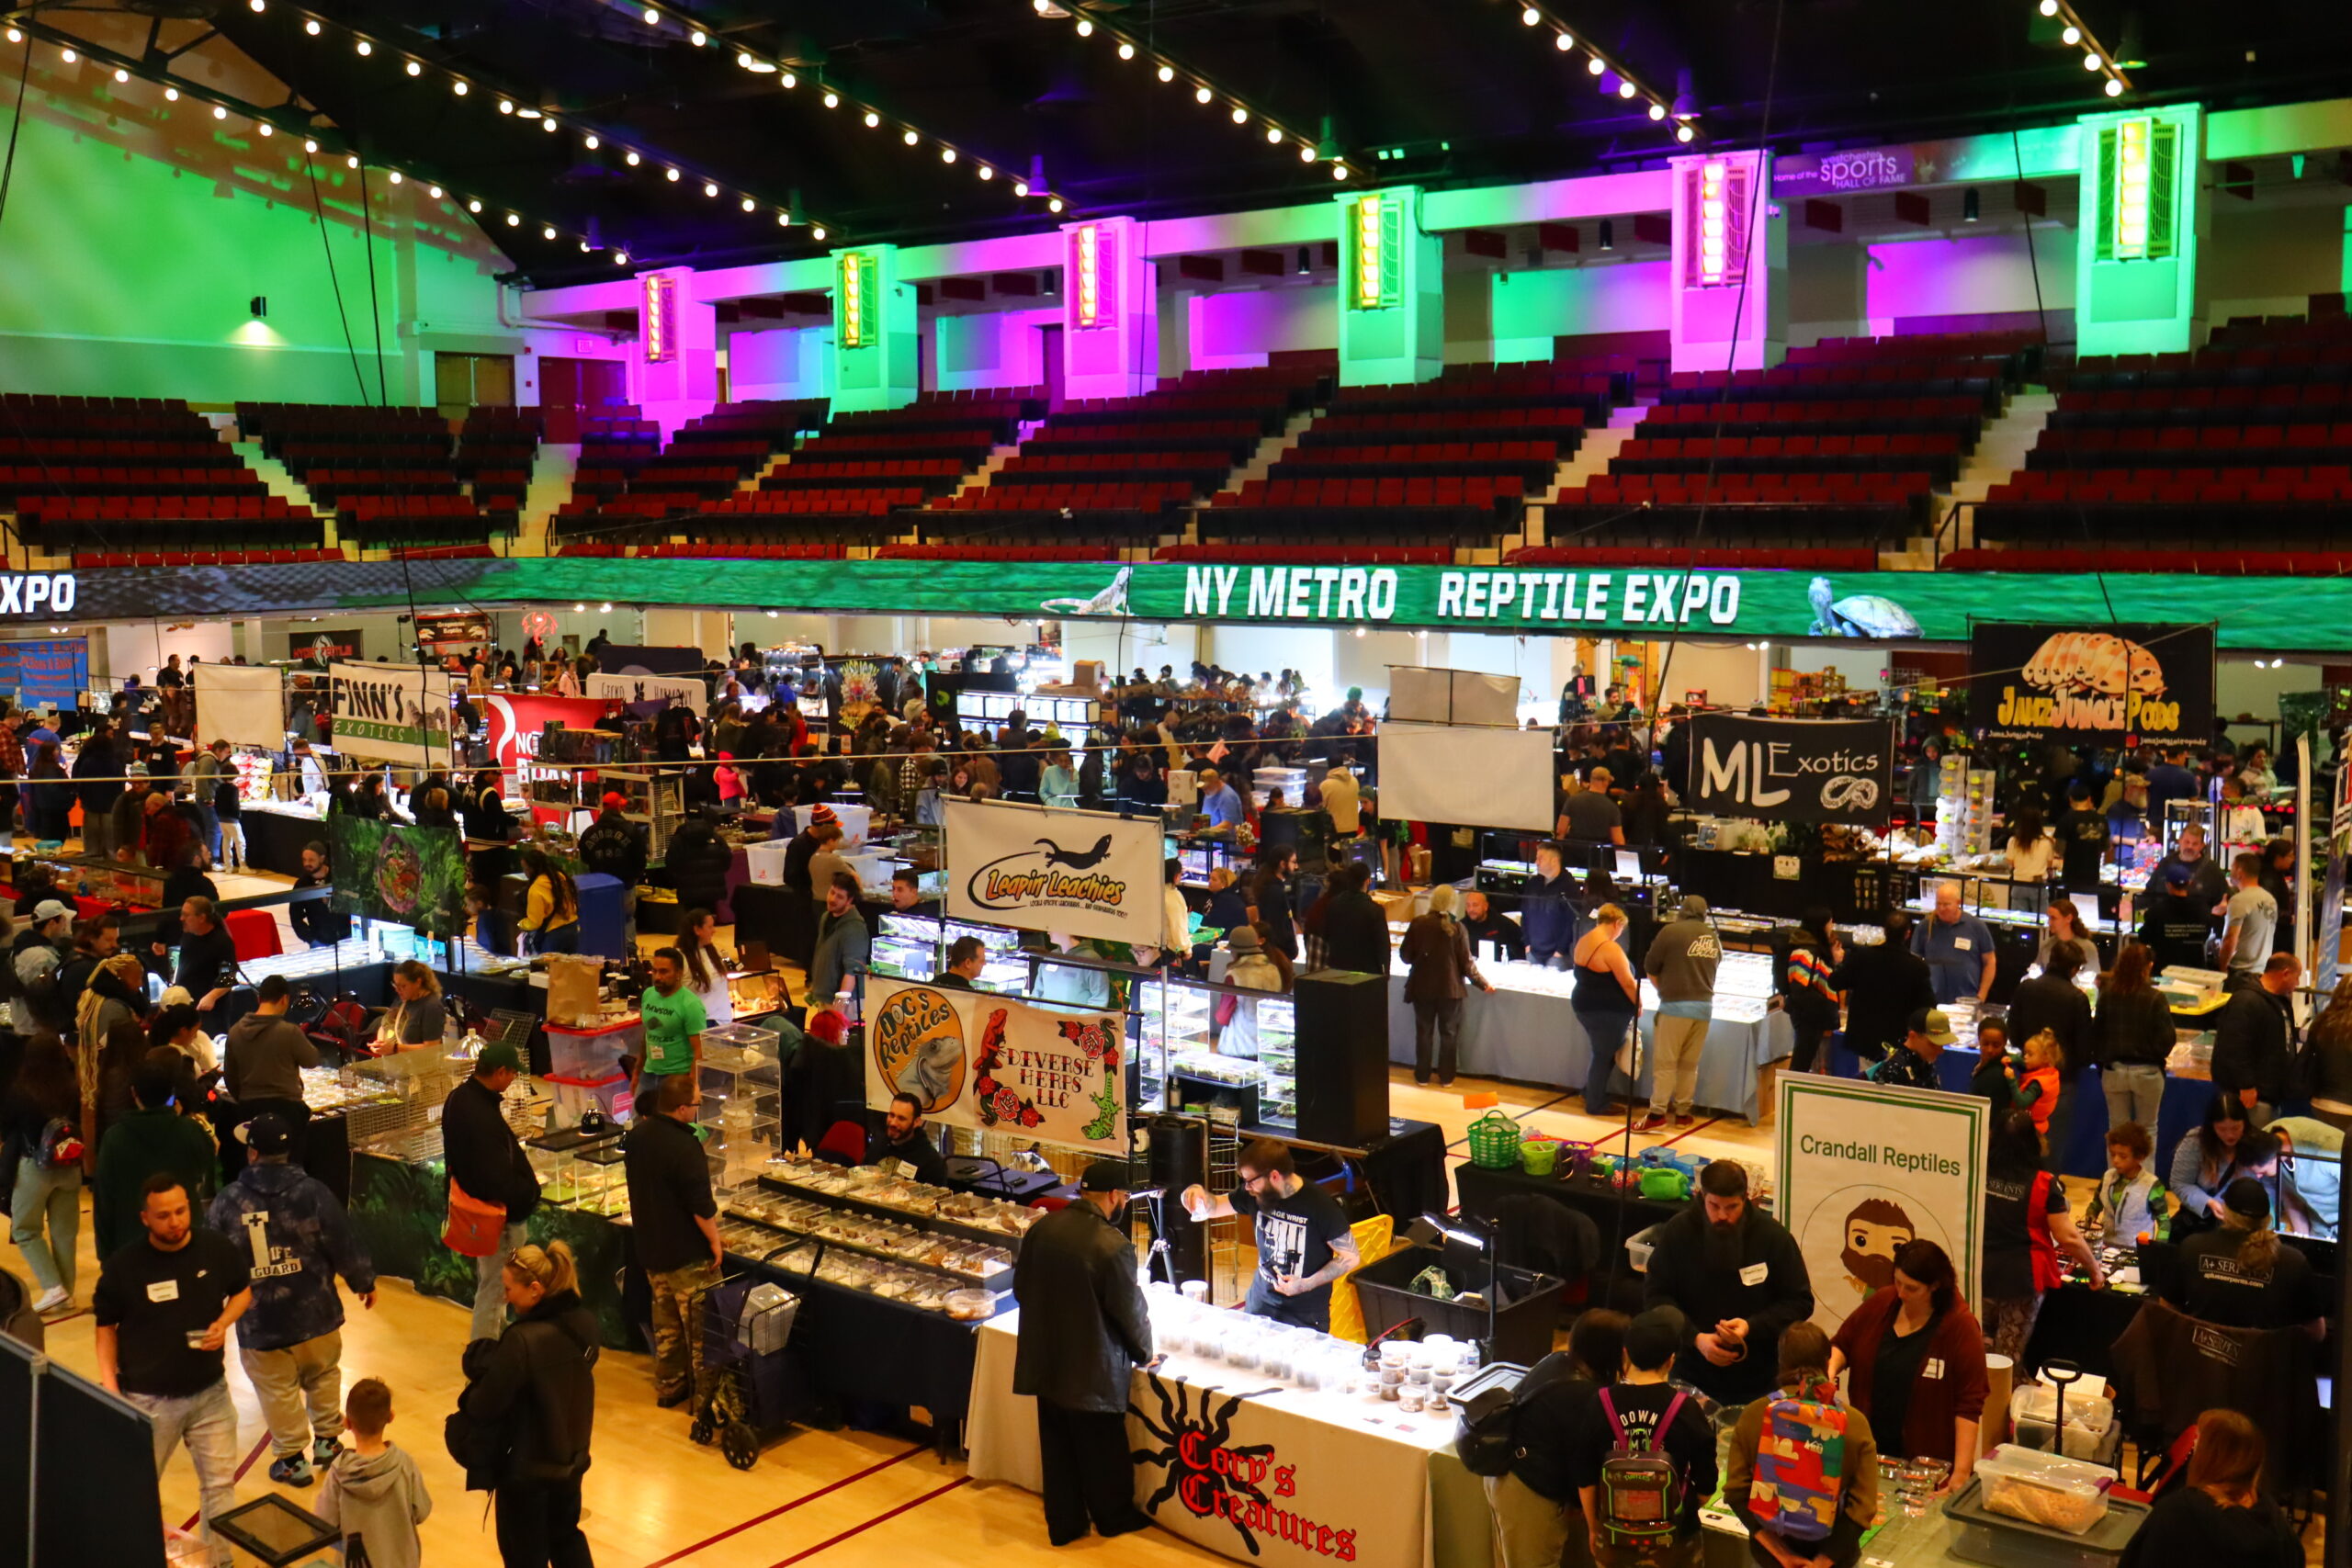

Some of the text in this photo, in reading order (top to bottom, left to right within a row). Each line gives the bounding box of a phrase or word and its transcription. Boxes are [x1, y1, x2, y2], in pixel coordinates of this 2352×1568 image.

[1821, 151, 1883, 164] westchester
[1821, 154, 1897, 186] sports
[1774, 173, 1795, 182] Home
[1836, 173, 1905, 189] HALL OF FAME
[0, 574, 76, 614] XPO
[1183, 567, 1743, 625] NY METRO REPTILE EXPO
[332, 677, 403, 723] FINN'S
[333, 720, 405, 741] EXOTICS
[1701, 738, 1879, 807] ML Exotics
[986, 869, 1126, 906] Leapin' Leachies
[1006, 1047, 1096, 1077] DIVERSE
[1020, 1068, 1082, 1093] HERPS
[1036, 1088, 1070, 1109] LLC
[1800, 1134, 1961, 1177] Crandall Reptiles
[1286, 1213, 1308, 1225] WRIST
[254, 1263, 300, 1278] GUARD
[1620, 1410, 1658, 1427] DOWN
[1179, 1430, 1296, 1497] Cory's
[1181, 1472, 1357, 1562] Creatures
